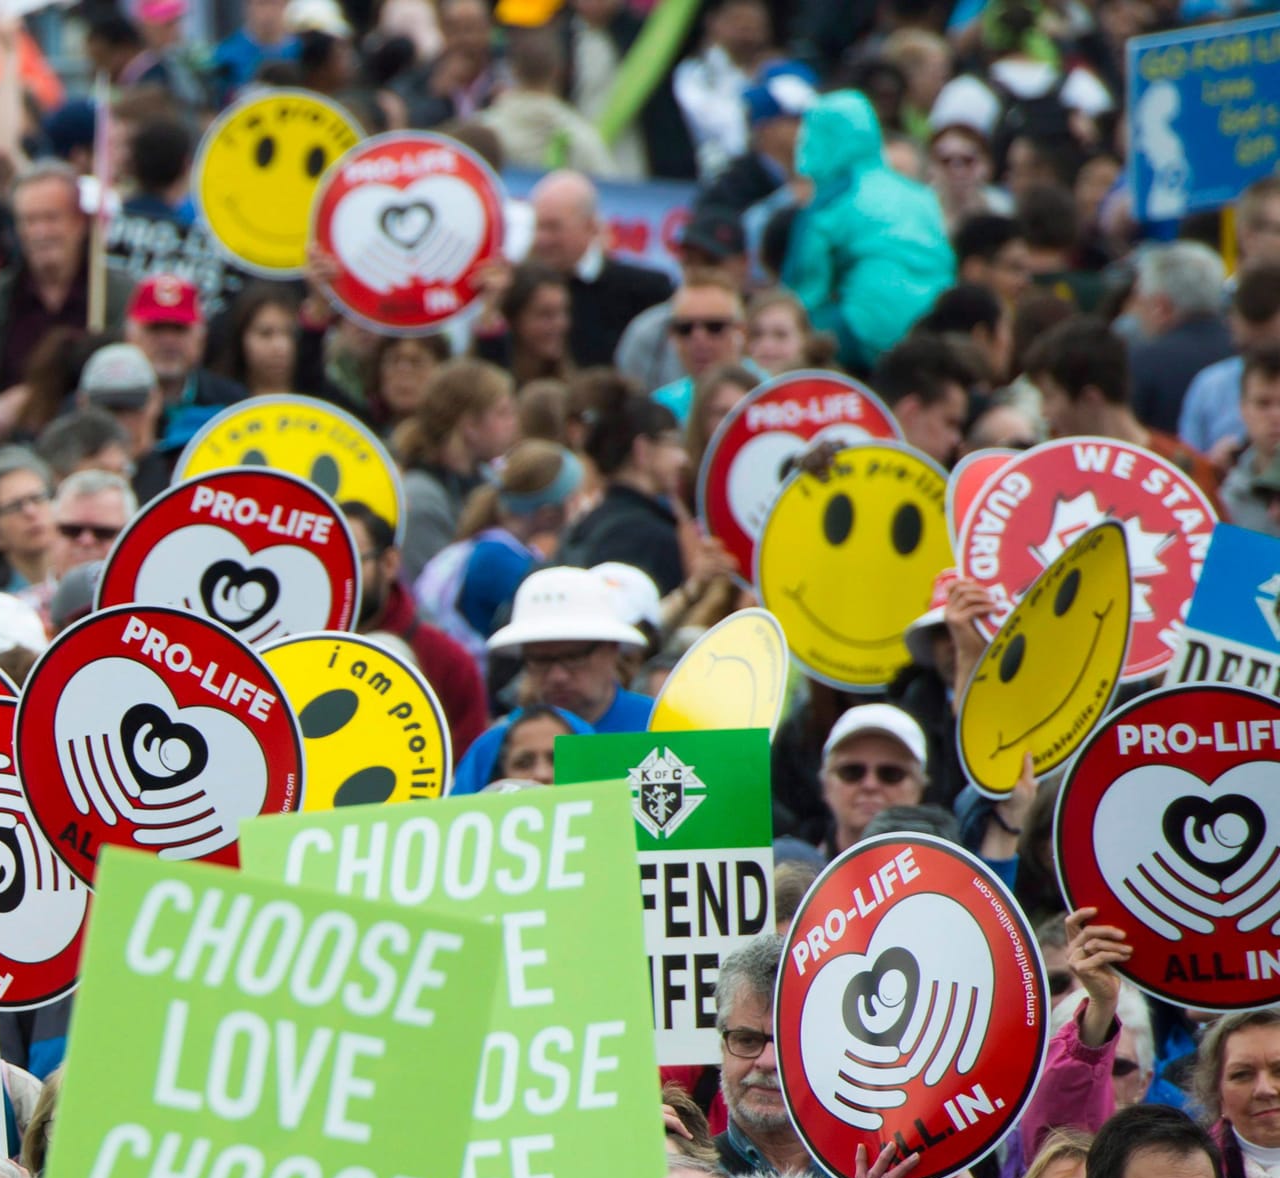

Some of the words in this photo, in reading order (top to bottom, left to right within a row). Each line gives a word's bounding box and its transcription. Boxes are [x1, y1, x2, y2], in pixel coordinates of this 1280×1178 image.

[746, 393, 864, 430] PRO-LIFE
[1073, 443, 1137, 481] WE
[191, 485, 335, 544] PRO-LIFE
[968, 470, 1033, 580] GUARD
[121, 616, 277, 724] PRO-LIFE
[327, 645, 341, 669] i
[350, 660, 394, 696] am
[641, 769, 651, 783] K
[671, 768, 683, 780] C
[125, 879, 465, 1028] CHOOSE
[791, 846, 922, 977] PRO-LIFE
[972, 877, 1036, 1027] campaignlifecoalition.com
[151, 999, 387, 1145] LOVE
